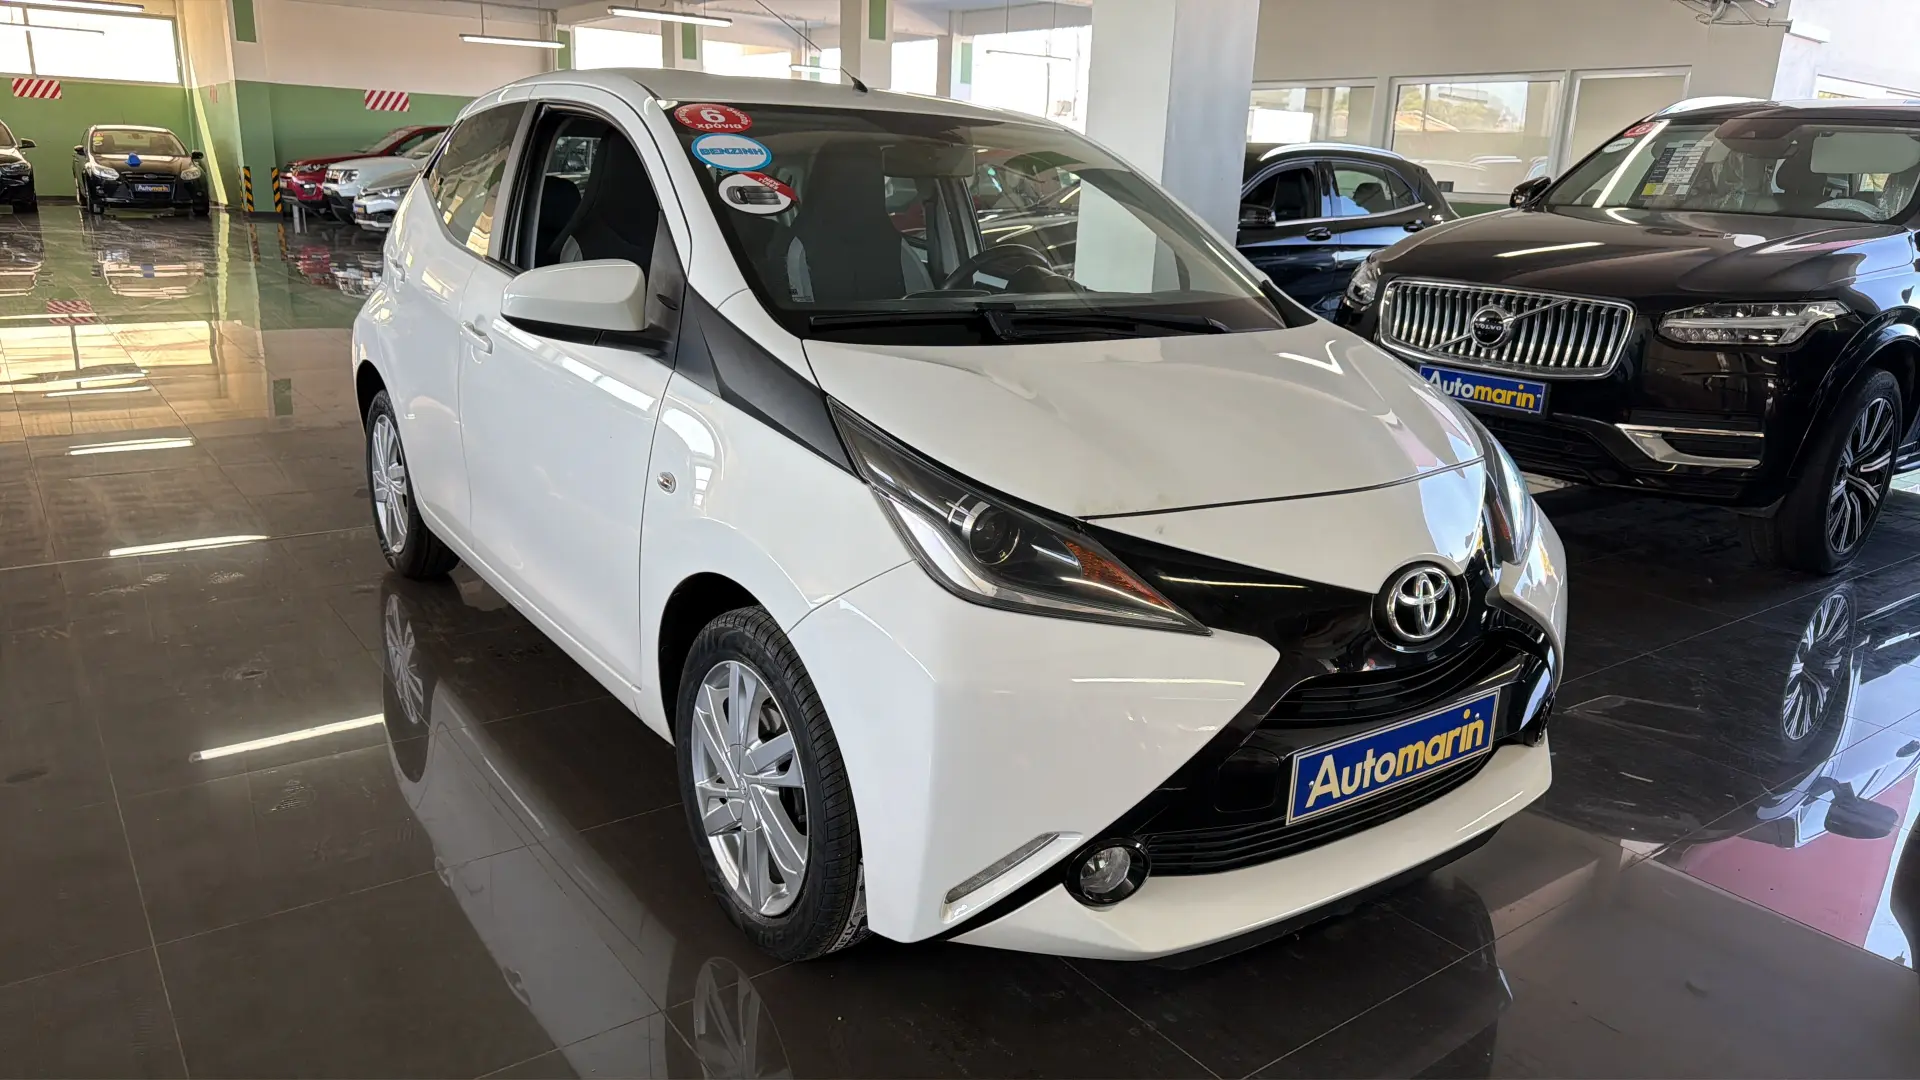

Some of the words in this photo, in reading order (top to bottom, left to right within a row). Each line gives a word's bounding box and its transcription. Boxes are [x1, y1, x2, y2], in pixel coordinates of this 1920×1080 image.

[700, 110, 726, 123] 6
[696, 122, 743, 130] χρόνια
[764, 176, 780, 186] NEW
[1475, 323, 1502, 331] VOLVO
[1427, 371, 1535, 409] Automarin
[1305, 708, 1484, 808] Automarin
